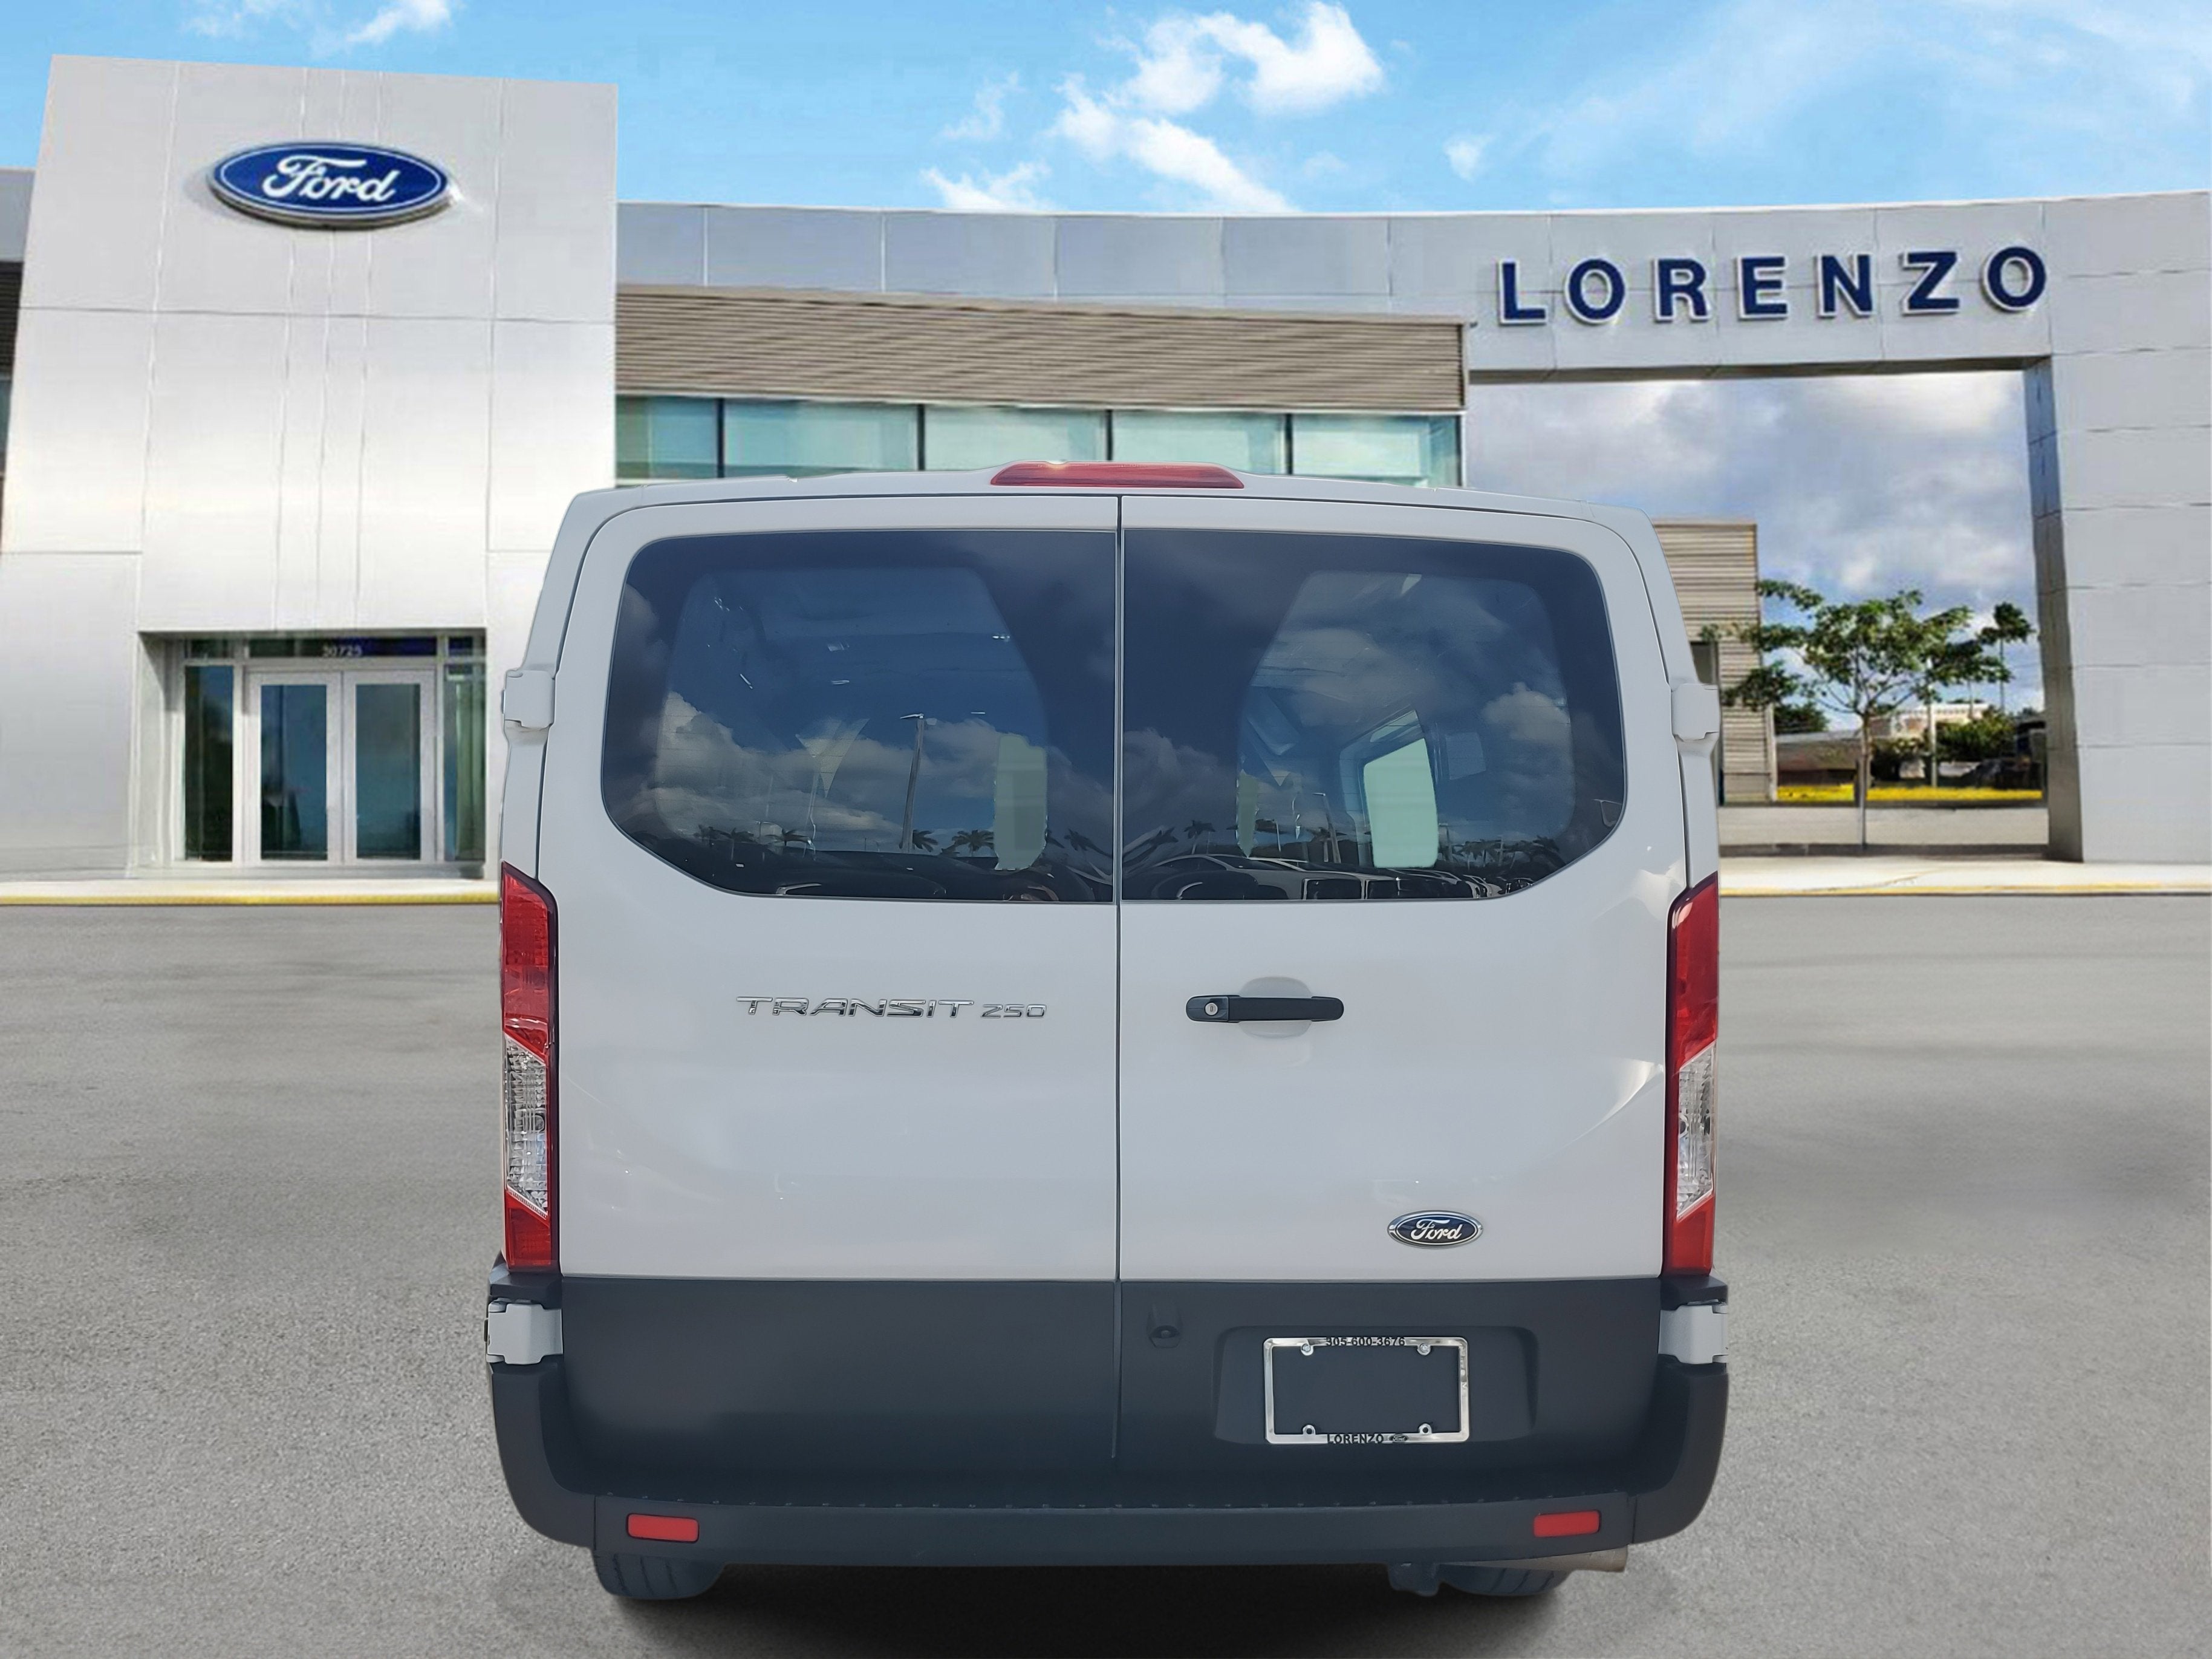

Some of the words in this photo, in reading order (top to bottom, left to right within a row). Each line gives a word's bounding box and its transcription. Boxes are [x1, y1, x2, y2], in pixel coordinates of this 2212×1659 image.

[261, 154, 401, 201] Ford
[1498, 246, 2048, 325] LORENZO
[735, 996, 975, 1018] TRANSIT
[980, 1003, 1048, 1019] 250
[1410, 1218, 1463, 1240] Ford
[1326, 1337, 1406, 1346] 305-600-3676
[1327, 1433, 1384, 1444] LORENZO
